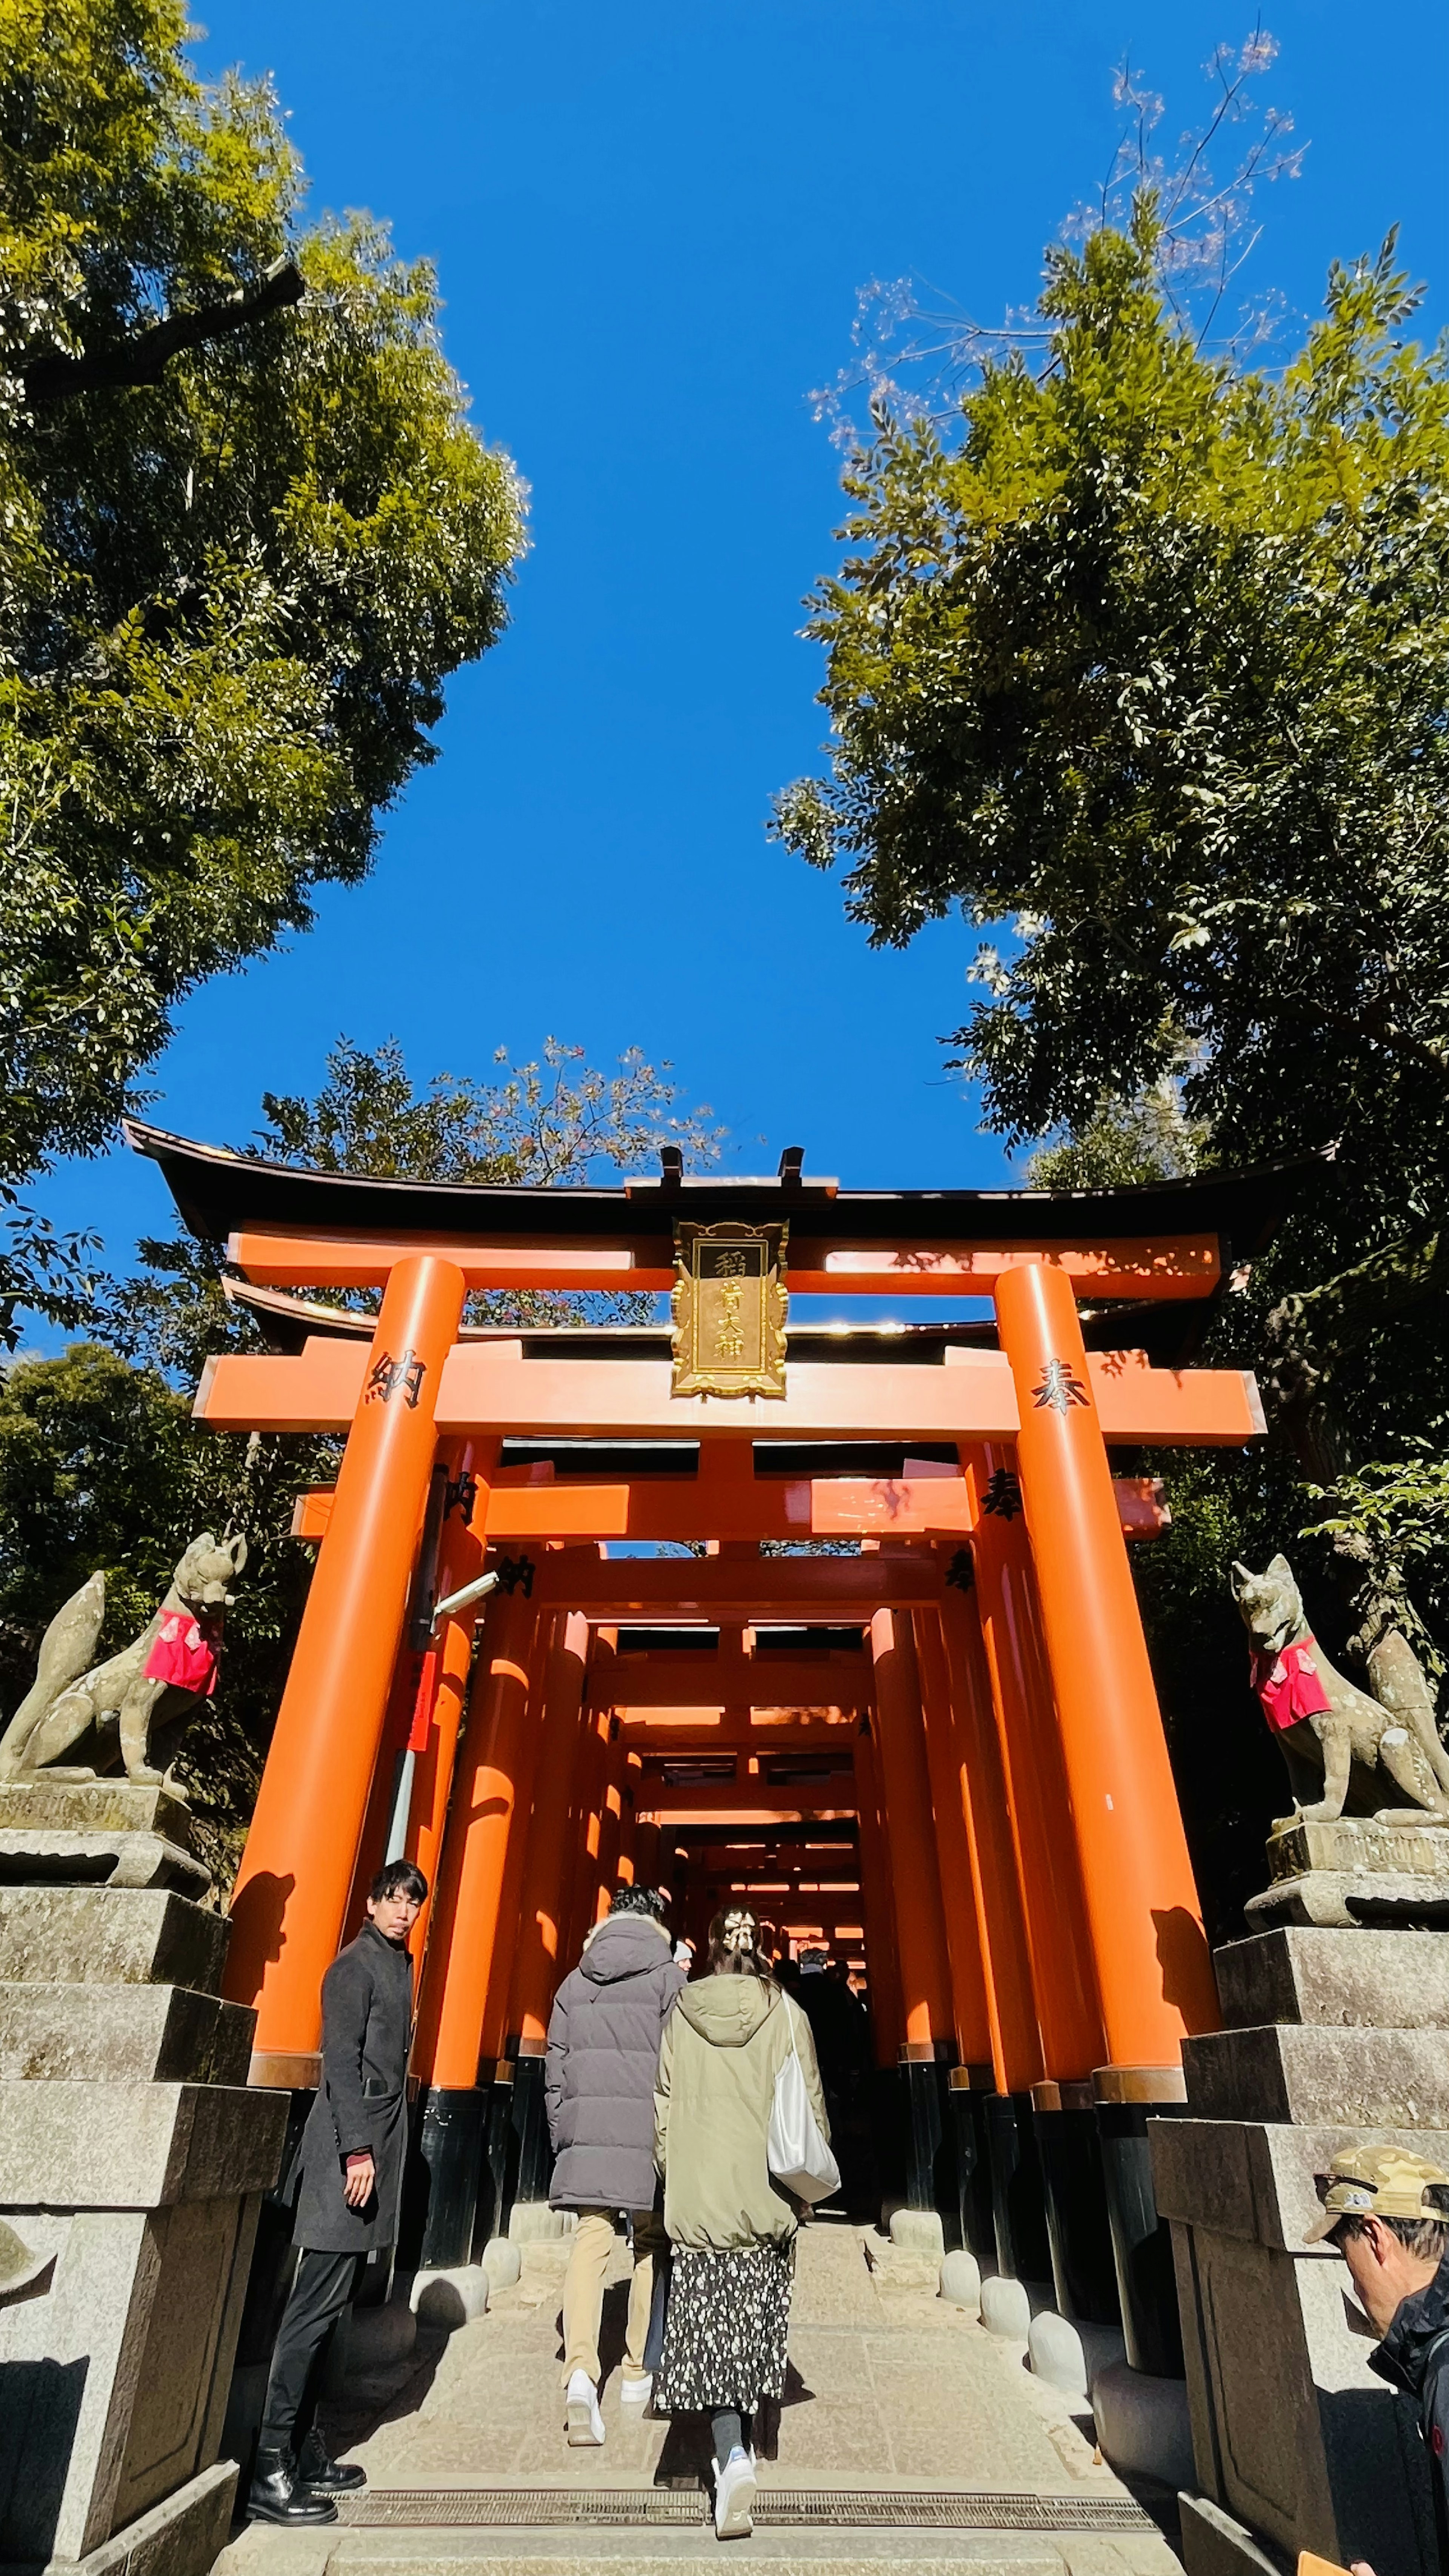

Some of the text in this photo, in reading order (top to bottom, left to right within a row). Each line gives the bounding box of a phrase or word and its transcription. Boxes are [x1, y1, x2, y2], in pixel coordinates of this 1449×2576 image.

[365, 1349, 428, 1409] 納
[1030, 1358, 1091, 1416] 奉
[980, 1467, 1021, 1522] 奉
